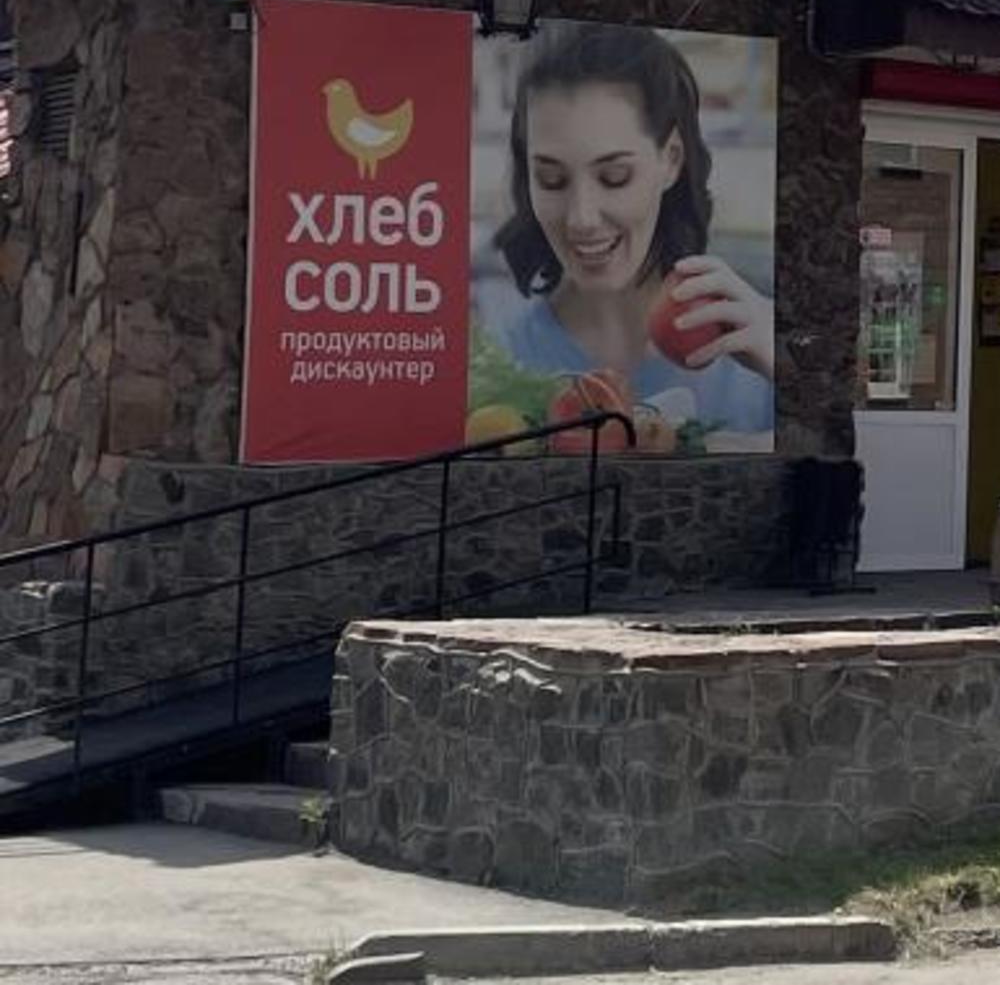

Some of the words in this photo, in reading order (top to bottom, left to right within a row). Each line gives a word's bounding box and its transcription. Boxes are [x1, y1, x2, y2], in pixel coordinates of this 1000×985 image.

[286, 181, 444, 247] хлеб
[285, 260, 442, 314] соль
[280, 327, 446, 354] продуктовый
[290, 360, 435, 386] дискаунтер
